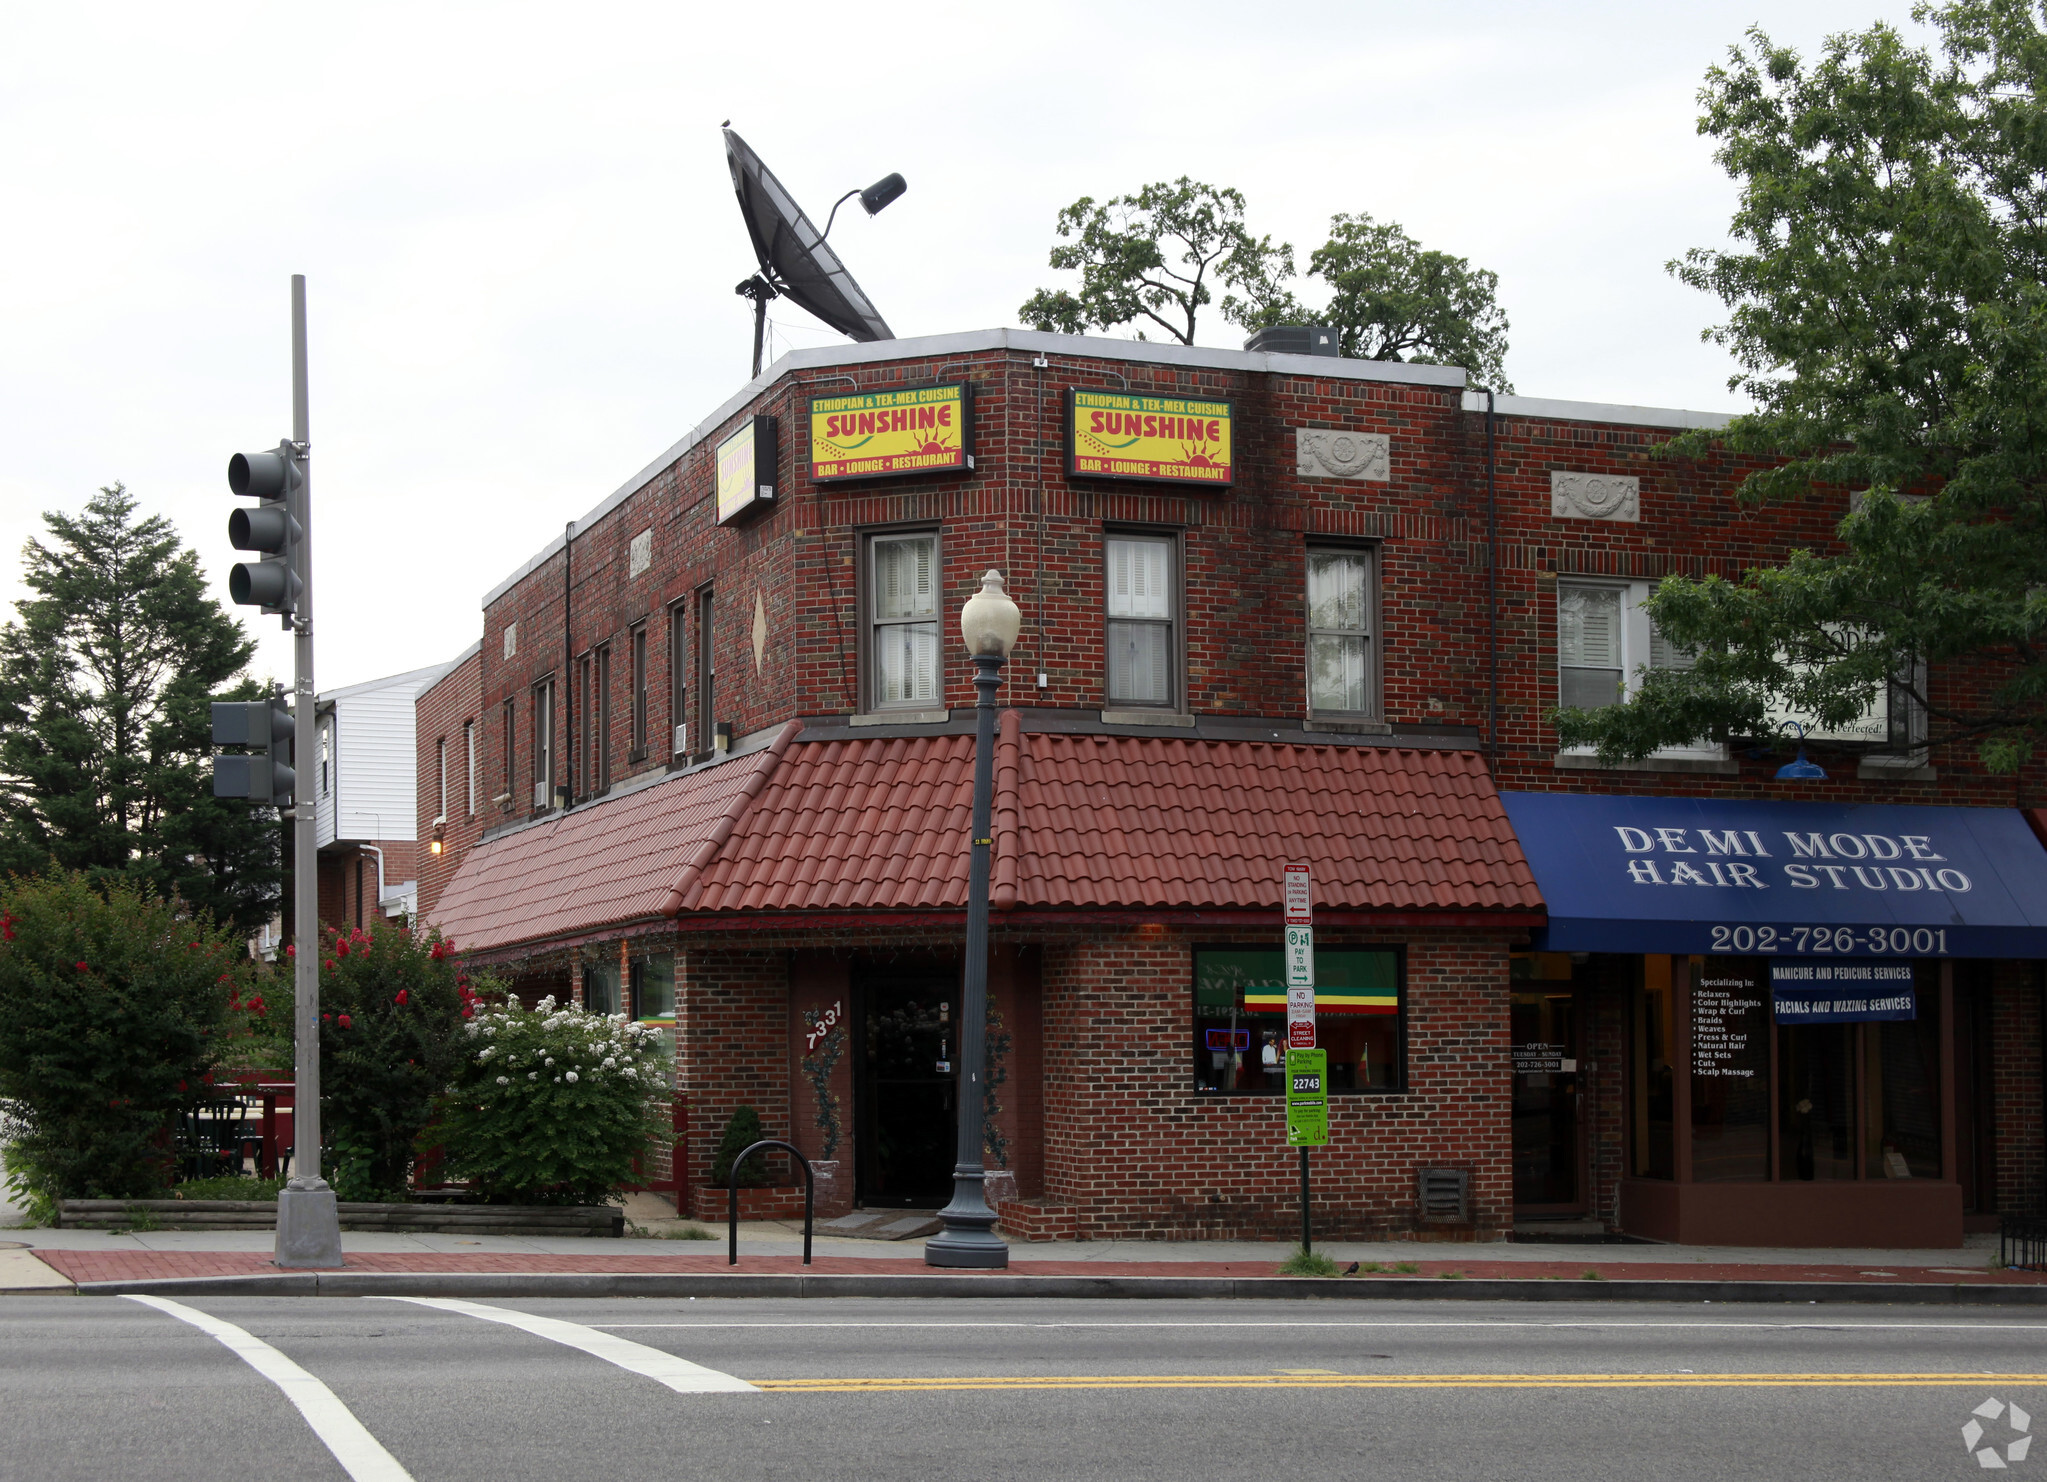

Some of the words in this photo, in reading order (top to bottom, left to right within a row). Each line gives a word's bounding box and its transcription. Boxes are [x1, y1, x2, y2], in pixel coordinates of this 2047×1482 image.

[813, 396, 864, 412] ETHIOPIAN
[866, 397, 874, 408] &
[875, 393, 917, 406] TEX-MEX
[919, 386, 960, 403] CUISINE
[1075, 393, 1130, 409] ETHIOPIAN
[1132, 400, 1140, 410] &
[1142, 398, 1186, 413] TEX-MEX
[1188, 402, 1228, 416] CUISINE
[826, 404, 951, 438] SUNSHINE
[1090, 410, 1220, 442] SUNSHINE
[722, 438, 752, 484] SUNSHINE
[818, 463, 838, 476] BAR
[846, 460, 884, 474] LOUNGE
[892, 452, 956, 470] RESTAURANT
[1080, 458, 1102, 472] BAR
[1110, 460, 1150, 475] LOUNGE
[1160, 464, 1225, 480] RESTAURANT
[1613, 826, 1774, 858] DEMI
[1782, 831, 1948, 862] MODE
[1626, 859, 1770, 890] HAIR
[1784, 863, 1972, 893] STUDIO
[1711, 925, 1948, 954] 202-726-3001
[1701, 978, 1743, 988] Specializing
[1773, 967, 1814, 980] MANICURE
[1816, 967, 1832, 980] AND
[1834, 967, 1872, 980] PEDICURE
[1874, 967, 1911, 980] SERVICES
[1698, 1008, 1717, 1016] Wrap
[1721, 1000, 1761, 1008] Highlights
[1775, 1001, 1810, 1014] FACIALS
[1812, 1000, 1830, 1013] AND
[1833, 1000, 1867, 1012] WAXING
[1870, 997, 1911, 1011] SERVICES
[806, 1001, 841, 1049] 7331
[1294, 1078, 1320, 1090] 22743
[1698, 1068, 1720, 1077] Scalp
[1722, 1068, 1754, 1077] Massage
